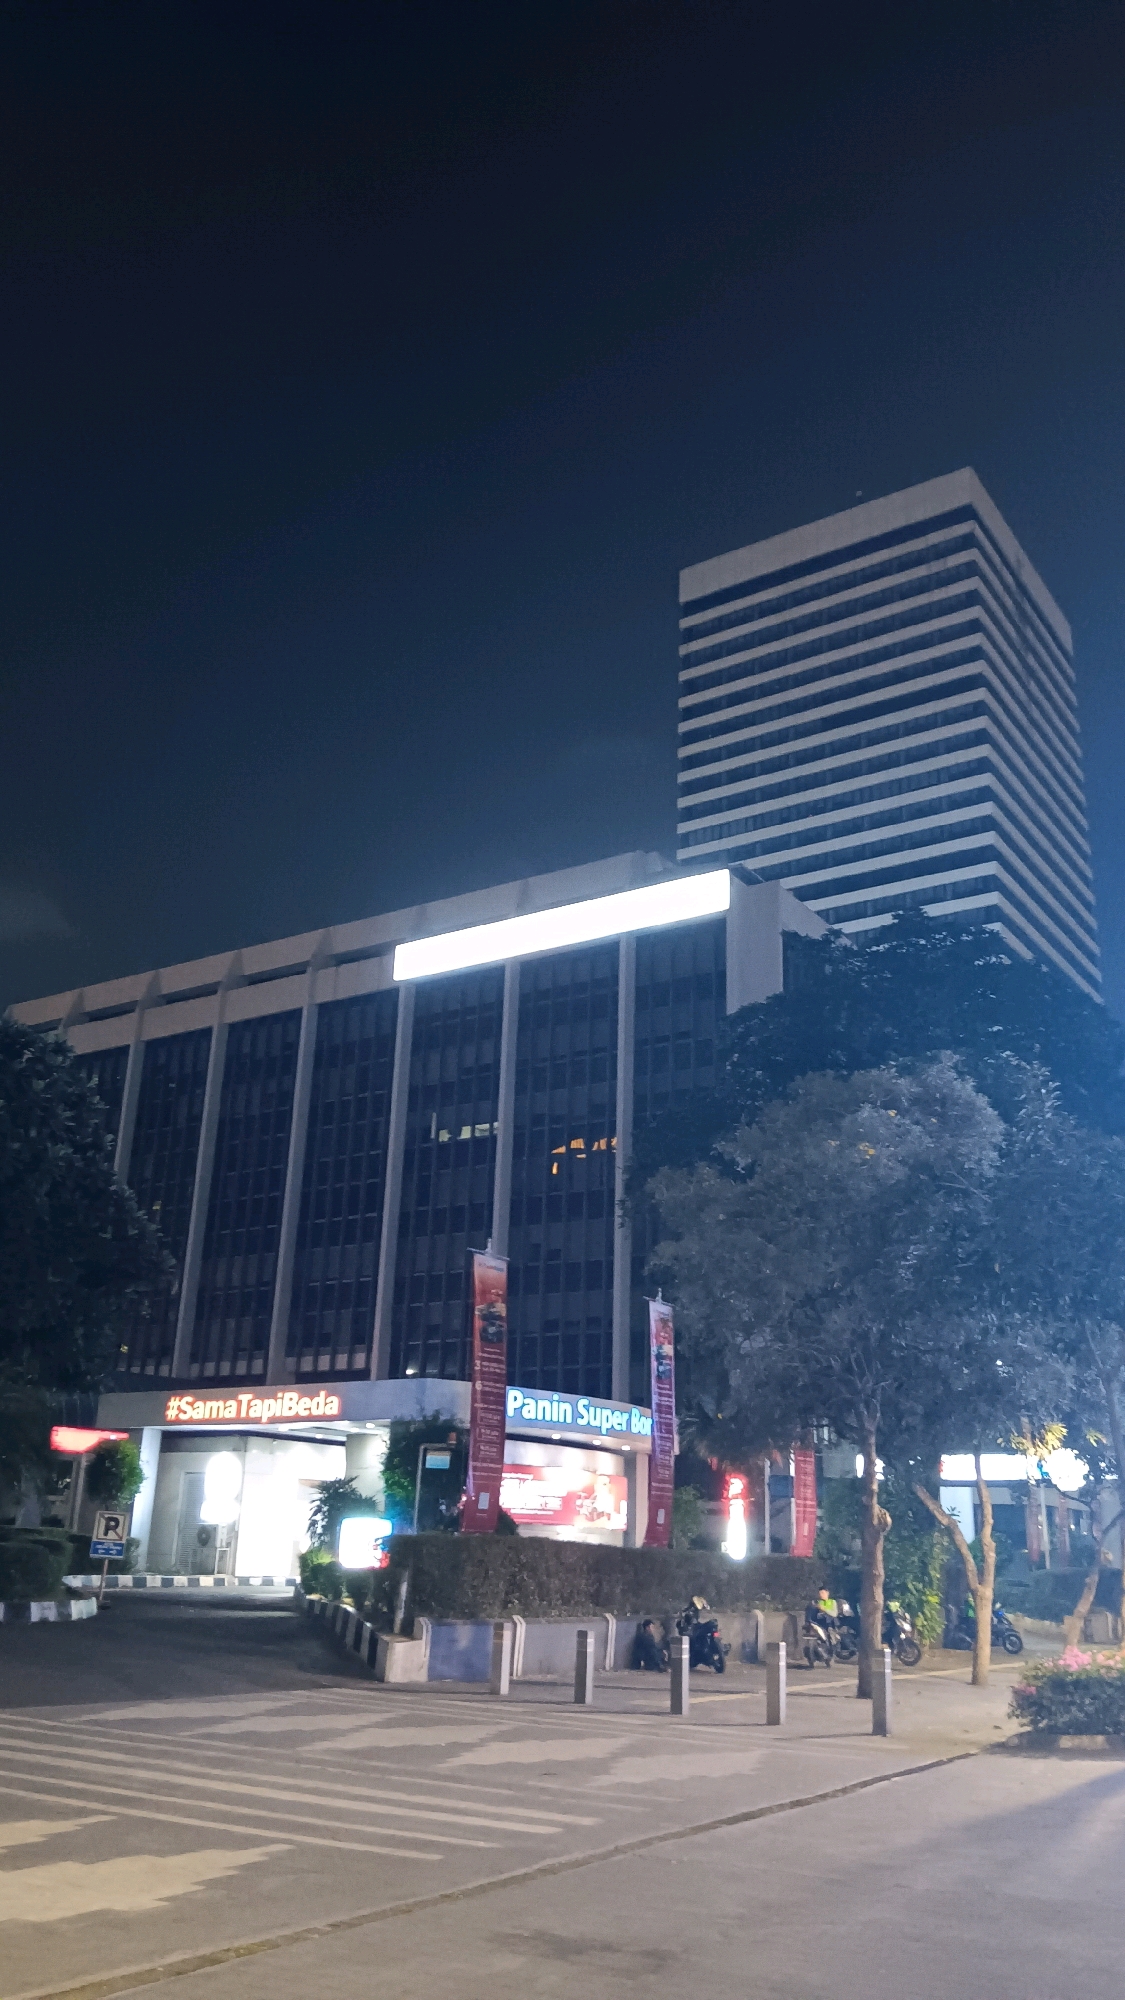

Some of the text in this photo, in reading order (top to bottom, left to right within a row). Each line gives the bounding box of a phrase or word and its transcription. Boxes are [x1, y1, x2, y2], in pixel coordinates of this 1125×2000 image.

[166, 1390, 340, 1424] #SamaTapiBeda
[506, 1388, 573, 1424] Panin
[576, 1397, 630, 1435] Super
